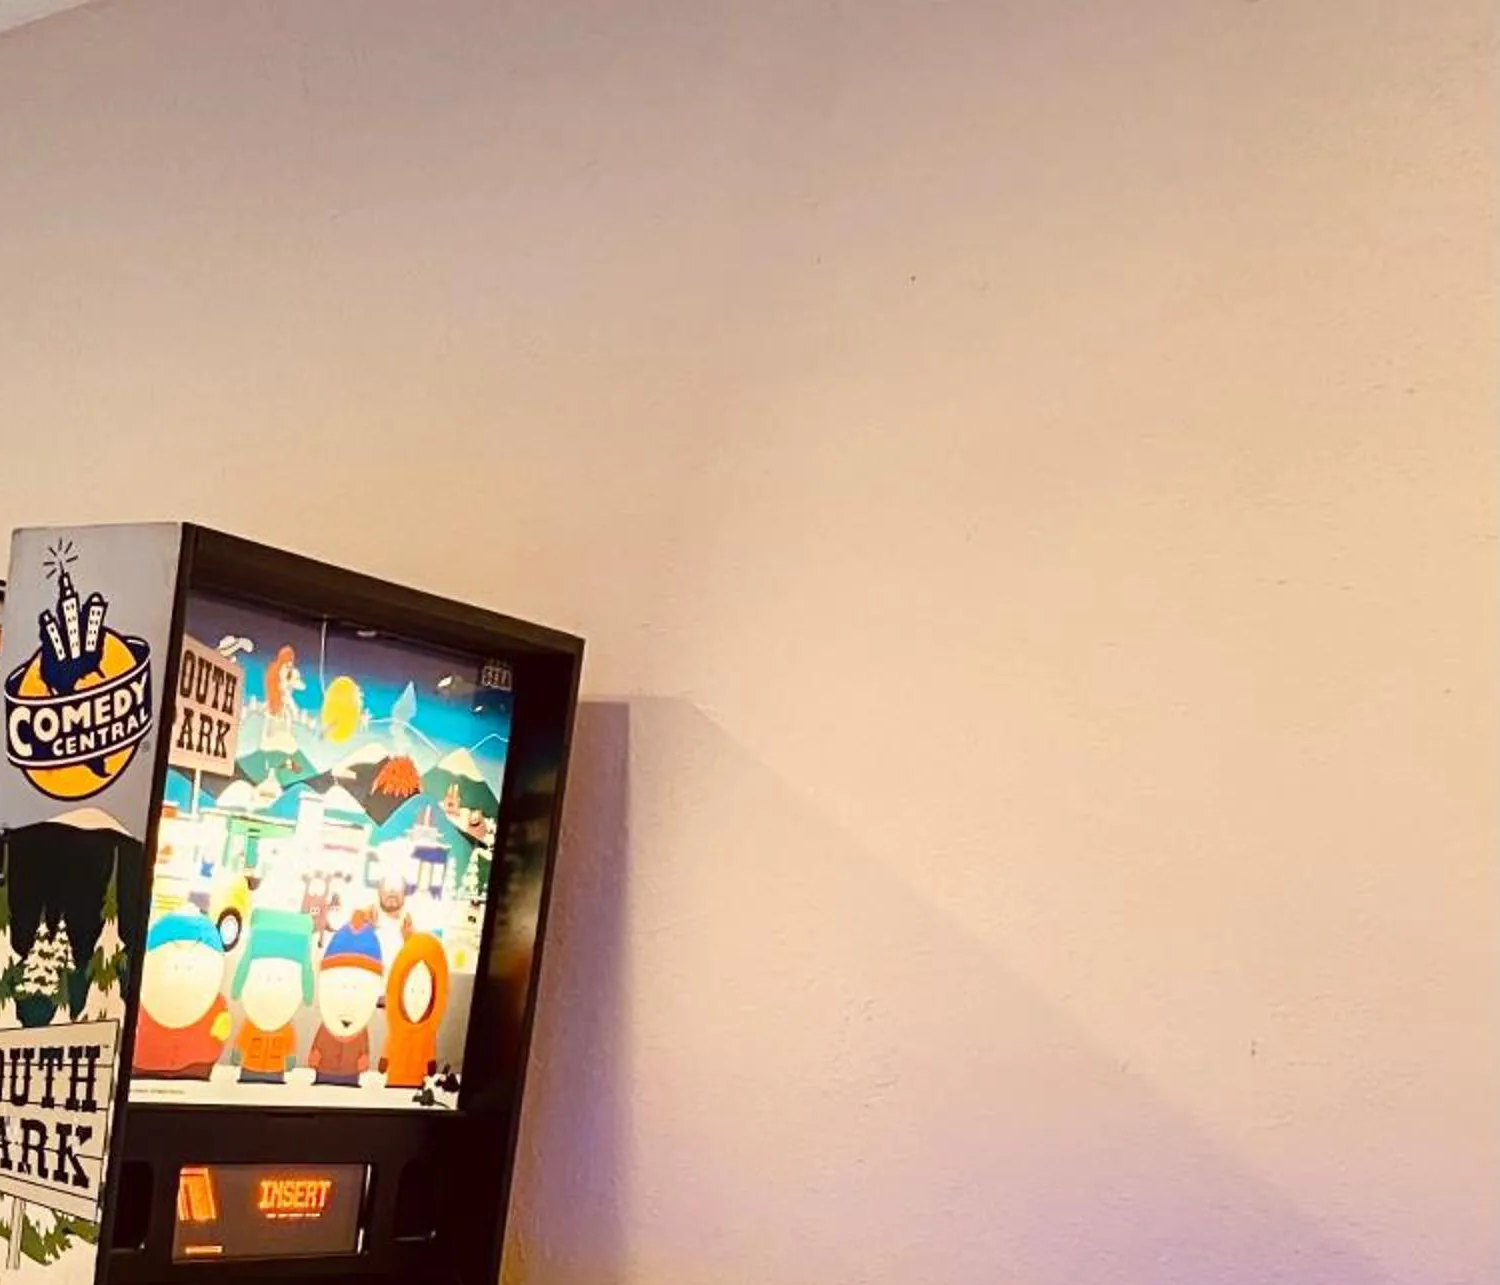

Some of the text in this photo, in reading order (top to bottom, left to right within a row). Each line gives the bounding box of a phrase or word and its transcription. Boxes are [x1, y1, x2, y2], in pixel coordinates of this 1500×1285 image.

[8, 673, 149, 756] COMEDY
[53, 709, 150, 757] CENTRAL
[258, 1180, 332, 1209] INSERT
